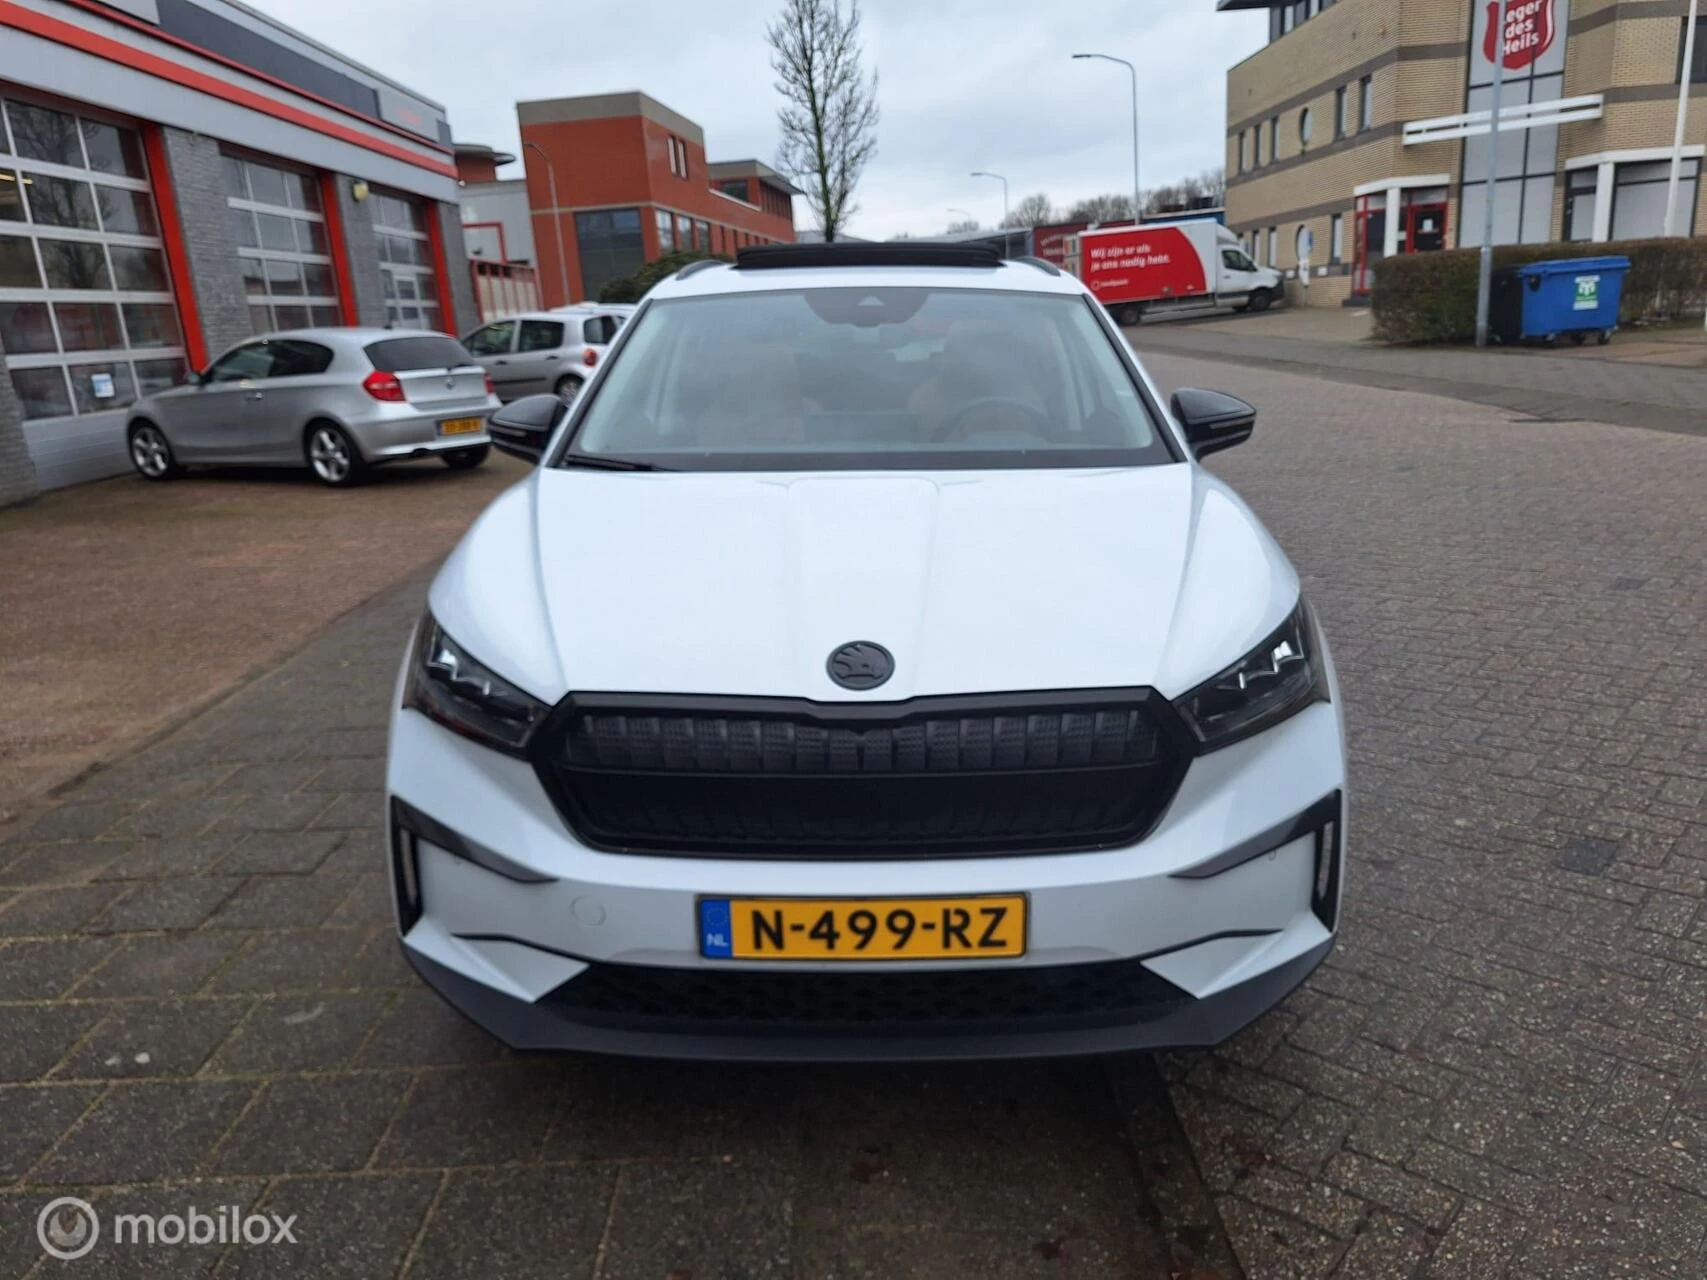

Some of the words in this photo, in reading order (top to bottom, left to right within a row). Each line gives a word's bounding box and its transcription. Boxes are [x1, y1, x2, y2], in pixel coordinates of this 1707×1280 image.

[1506, 0, 1542, 22] eger
[1505, 19, 1533, 39] des
[706, 933, 729, 947] NL
[751, 907, 1007, 950] N-499-RZ
